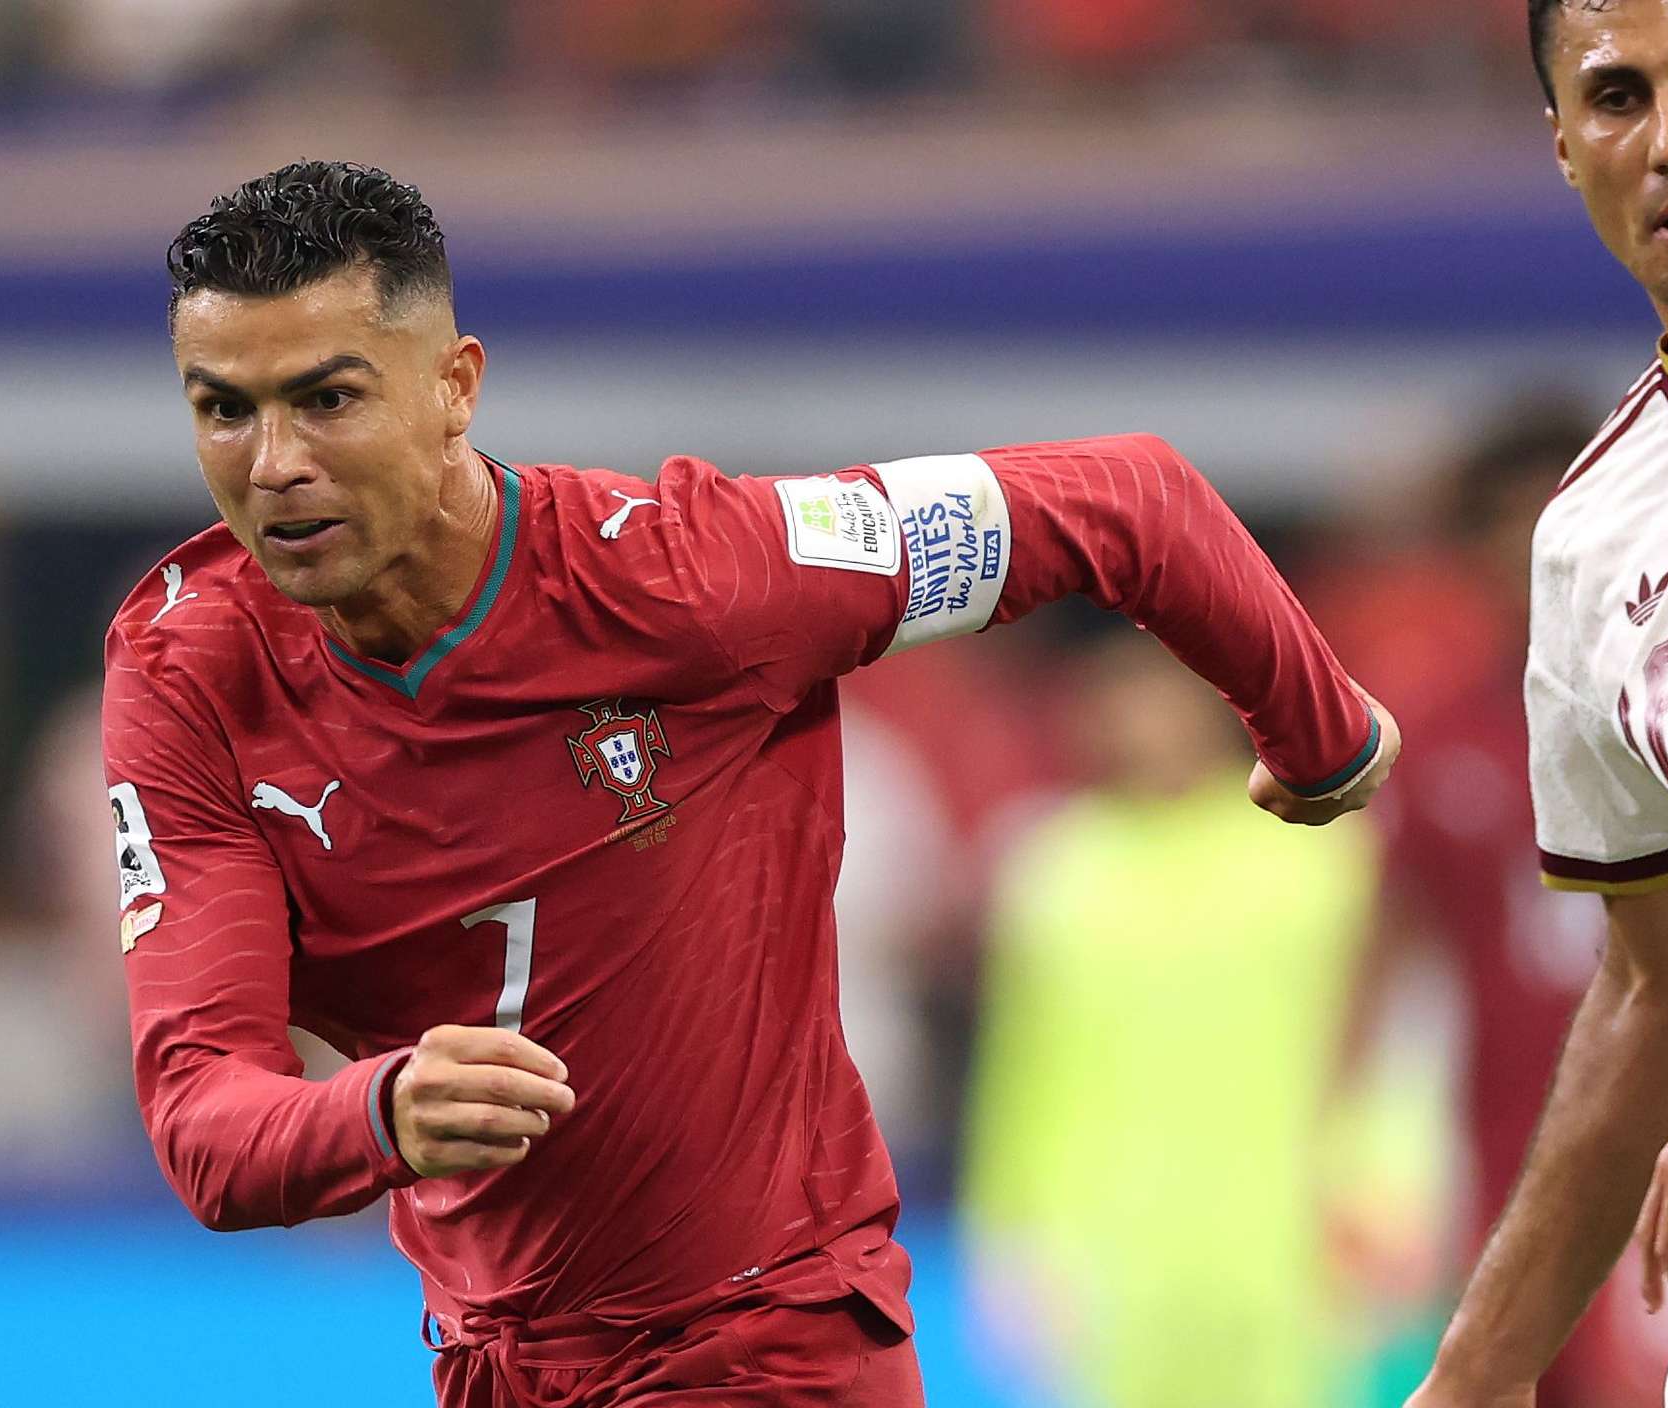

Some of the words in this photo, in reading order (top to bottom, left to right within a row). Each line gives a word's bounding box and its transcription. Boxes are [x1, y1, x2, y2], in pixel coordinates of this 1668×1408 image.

[851, 493, 878, 553] EDUCATION
[918, 502, 951, 618] UNITES
[944, 492, 979, 573] World
[982, 531, 999, 579] FIFA
[902, 509, 926, 623] FOOTBALL
[947, 576, 973, 614] the
[460, 897, 537, 1036] 7
